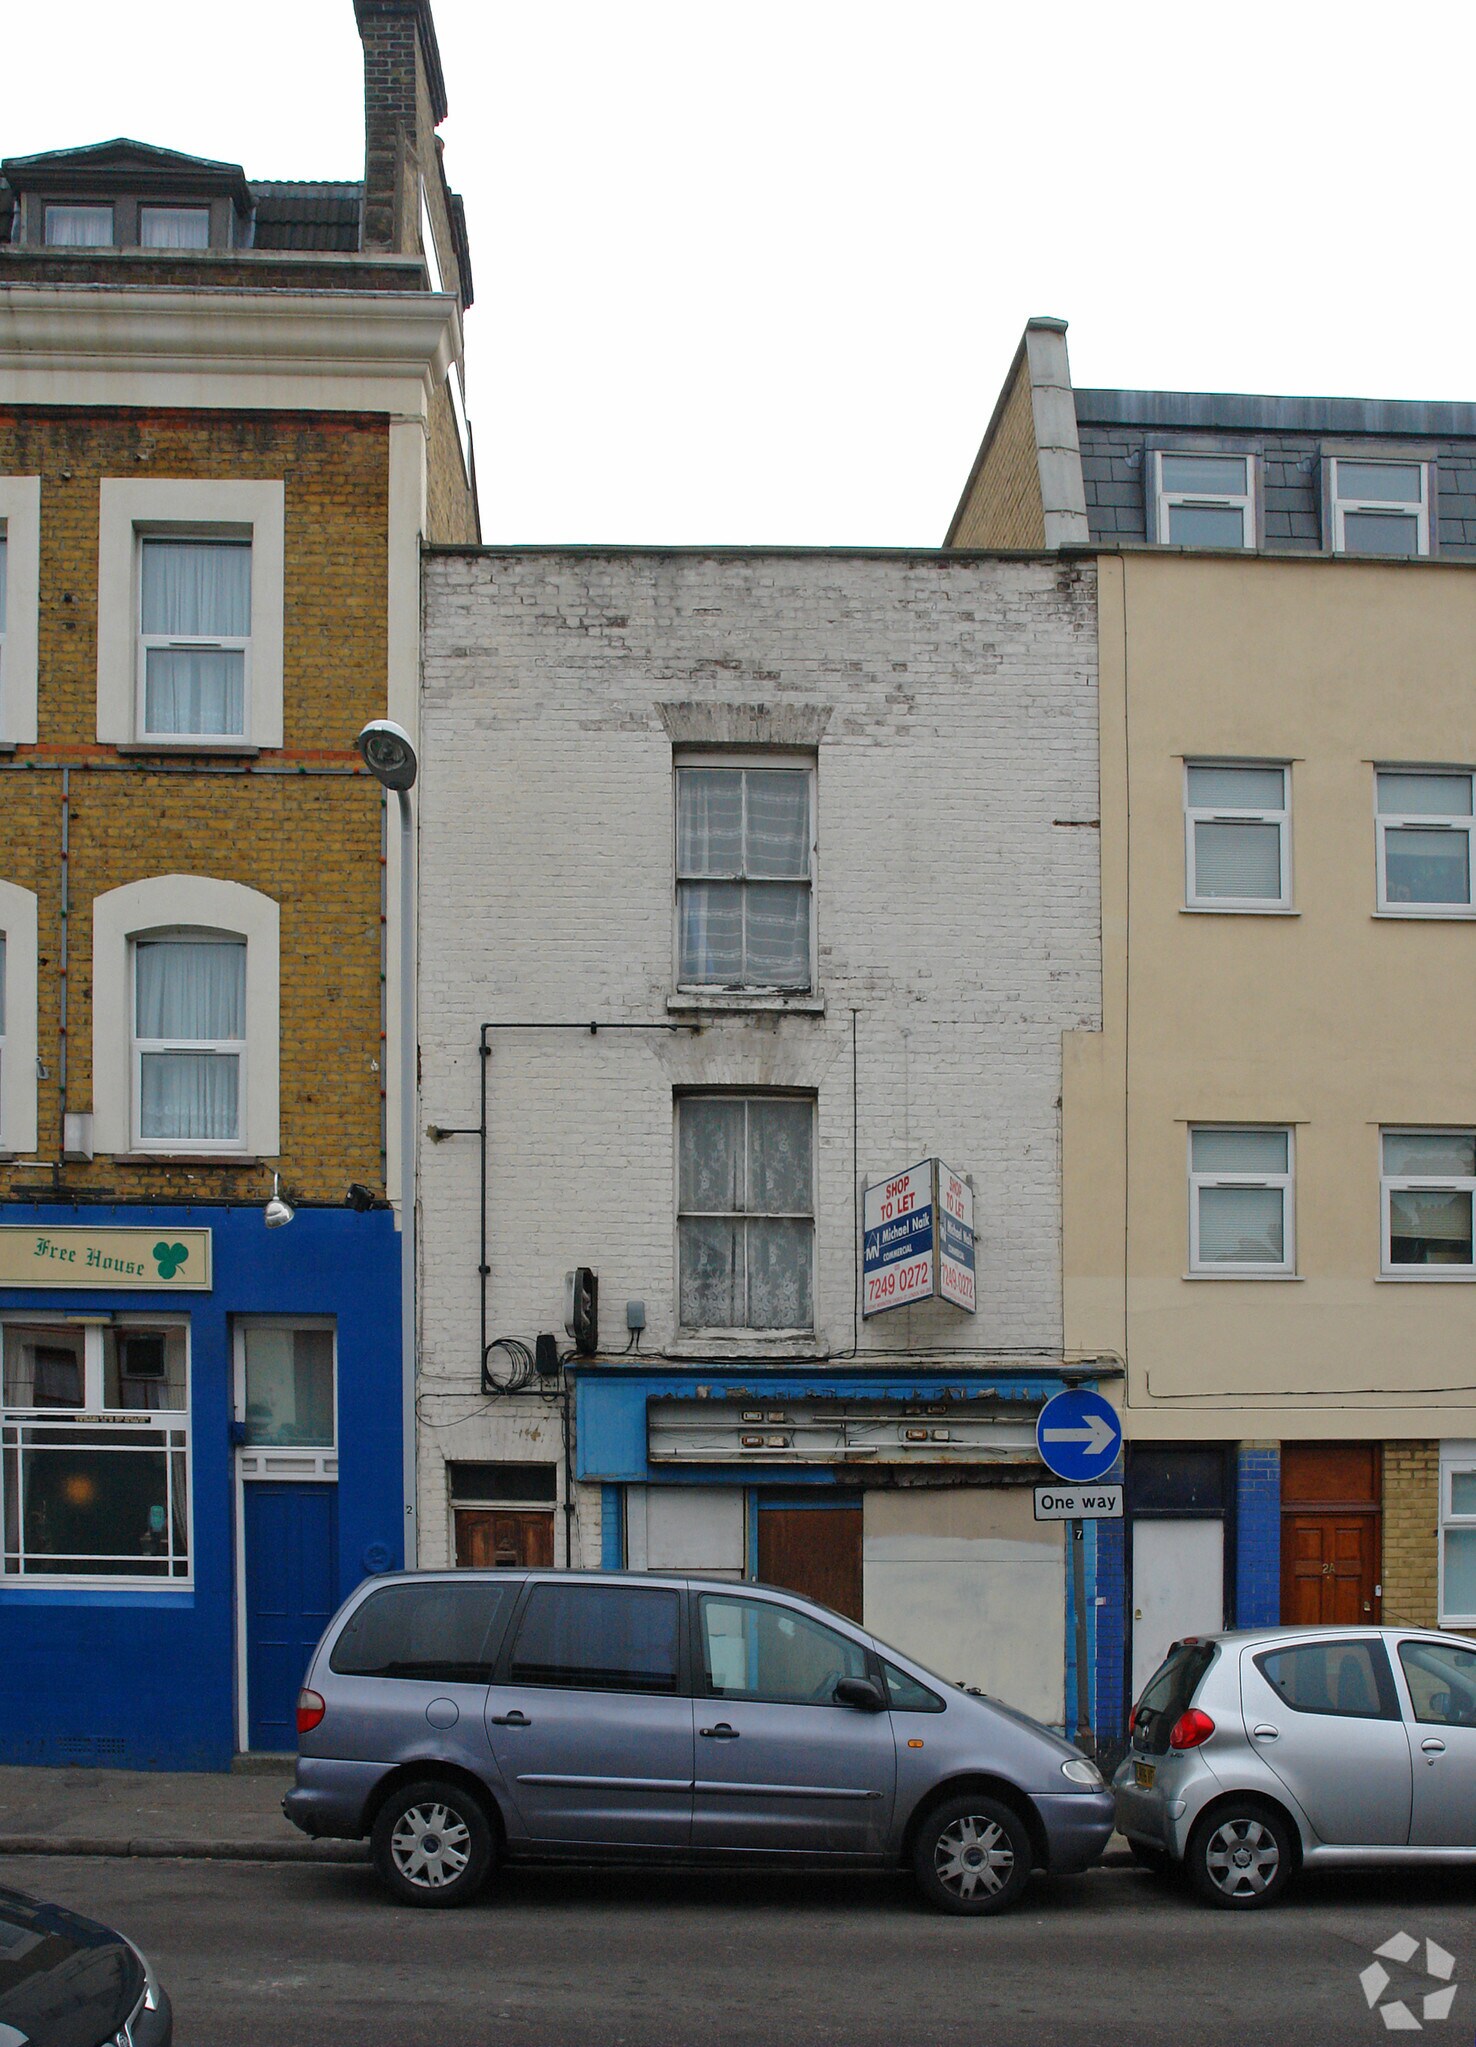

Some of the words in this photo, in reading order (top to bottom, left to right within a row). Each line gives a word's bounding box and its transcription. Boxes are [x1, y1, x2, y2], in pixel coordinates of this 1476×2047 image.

[885, 1175, 910, 1200] SHOP
[880, 1201, 893, 1222] TO
[897, 1191, 916, 1215] LET
[946, 1191, 954, 1212] TO
[955, 1199, 965, 1220] LET
[882, 1219, 910, 1244] Michael
[912, 1211, 930, 1232] Naik
[33, 1237, 76, 1263] Free
[84, 1247, 145, 1277] House
[868, 1272, 896, 1302] 7249
[899, 1261, 929, 1292] 0272
[406, 1505, 413, 1515] 2
[1041, 1494, 1075, 1510] One
[1082, 1496, 1117, 1511] way
[1075, 1530, 1083, 1540] 7
[1322, 1562, 1335, 1574] 2A
